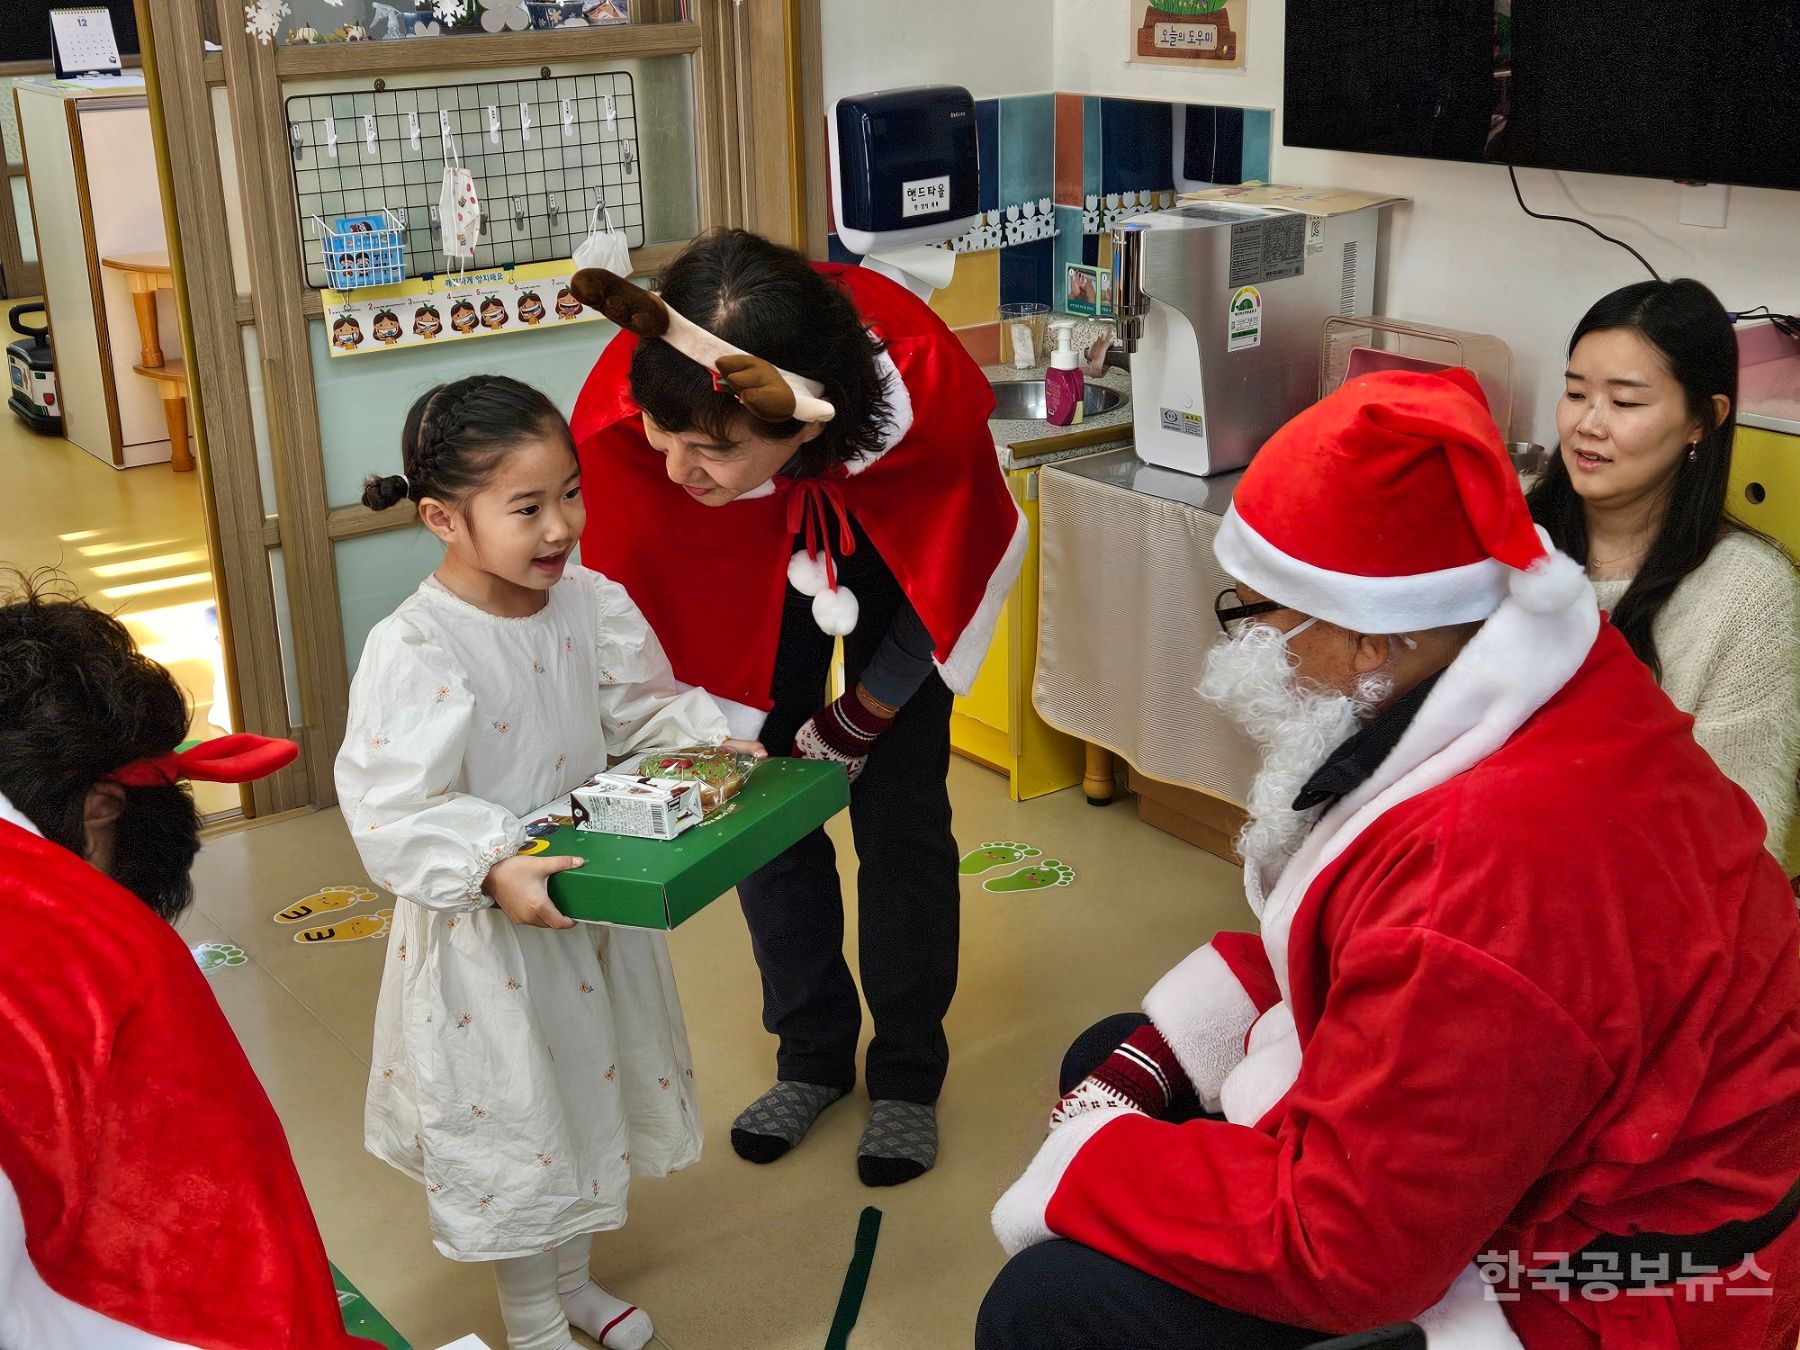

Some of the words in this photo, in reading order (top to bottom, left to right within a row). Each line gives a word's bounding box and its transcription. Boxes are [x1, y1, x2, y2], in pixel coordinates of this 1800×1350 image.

[76, 18, 88, 27] 12
[1160, 25, 1186, 47] 오늘의
[1187, 30, 1213, 46] 도우미
[906, 183, 945, 202] 핸드타올
[475, 272, 504, 285] 양치해요
